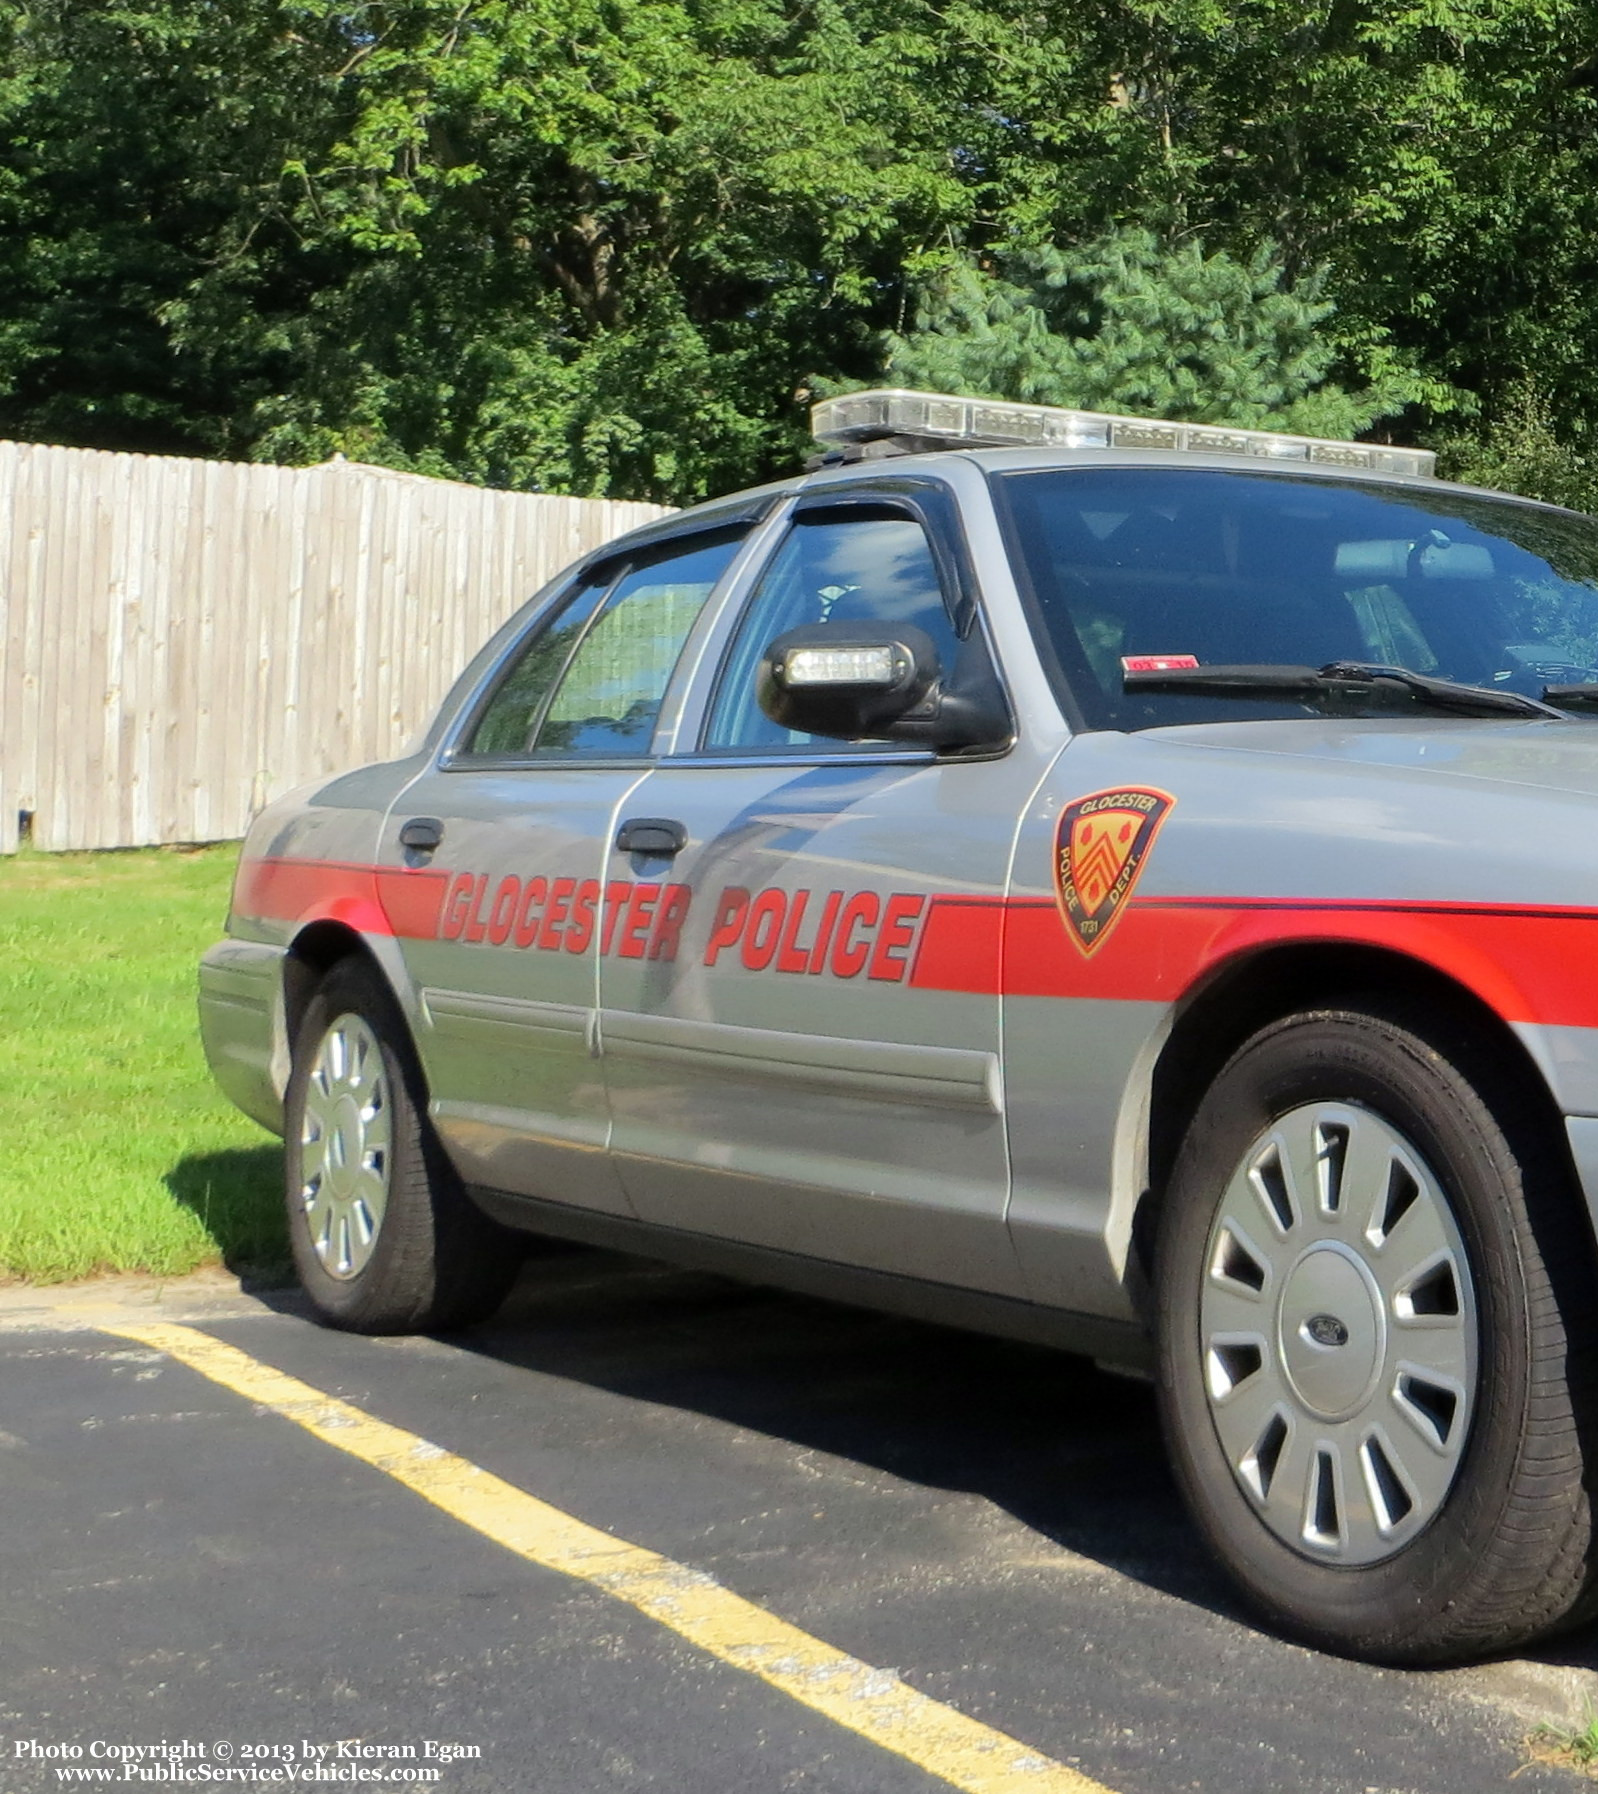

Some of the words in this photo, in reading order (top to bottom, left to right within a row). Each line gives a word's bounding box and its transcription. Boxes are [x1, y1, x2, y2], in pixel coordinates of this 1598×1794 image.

[1079, 793, 1157, 815] GLOCESTER
[1060, 846, 1079, 912] POLICE
[1108, 854, 1142, 906] DEPT.
[442, 872, 692, 962] GLOCESTER
[703, 885, 927, 983] POLICE
[1080, 920, 1099, 933] 1731
